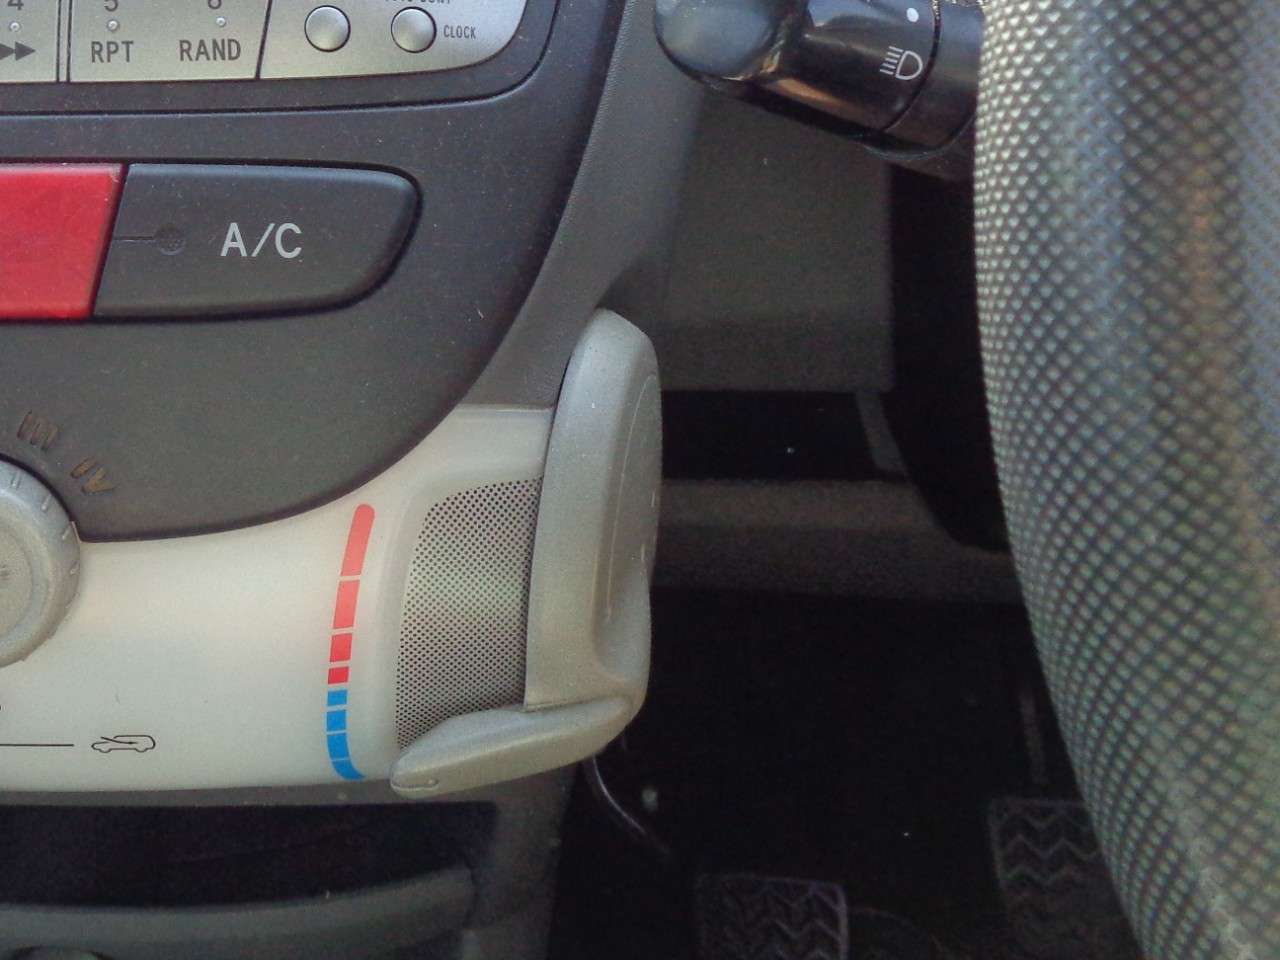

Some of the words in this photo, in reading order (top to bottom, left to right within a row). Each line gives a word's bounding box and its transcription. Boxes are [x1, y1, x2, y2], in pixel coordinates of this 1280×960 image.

[443, 25, 476, 40] CLOCK
[90, 40, 134, 64] RPT
[178, 38, 242, 62] RAND
[222, 222, 303, 259] A/C
